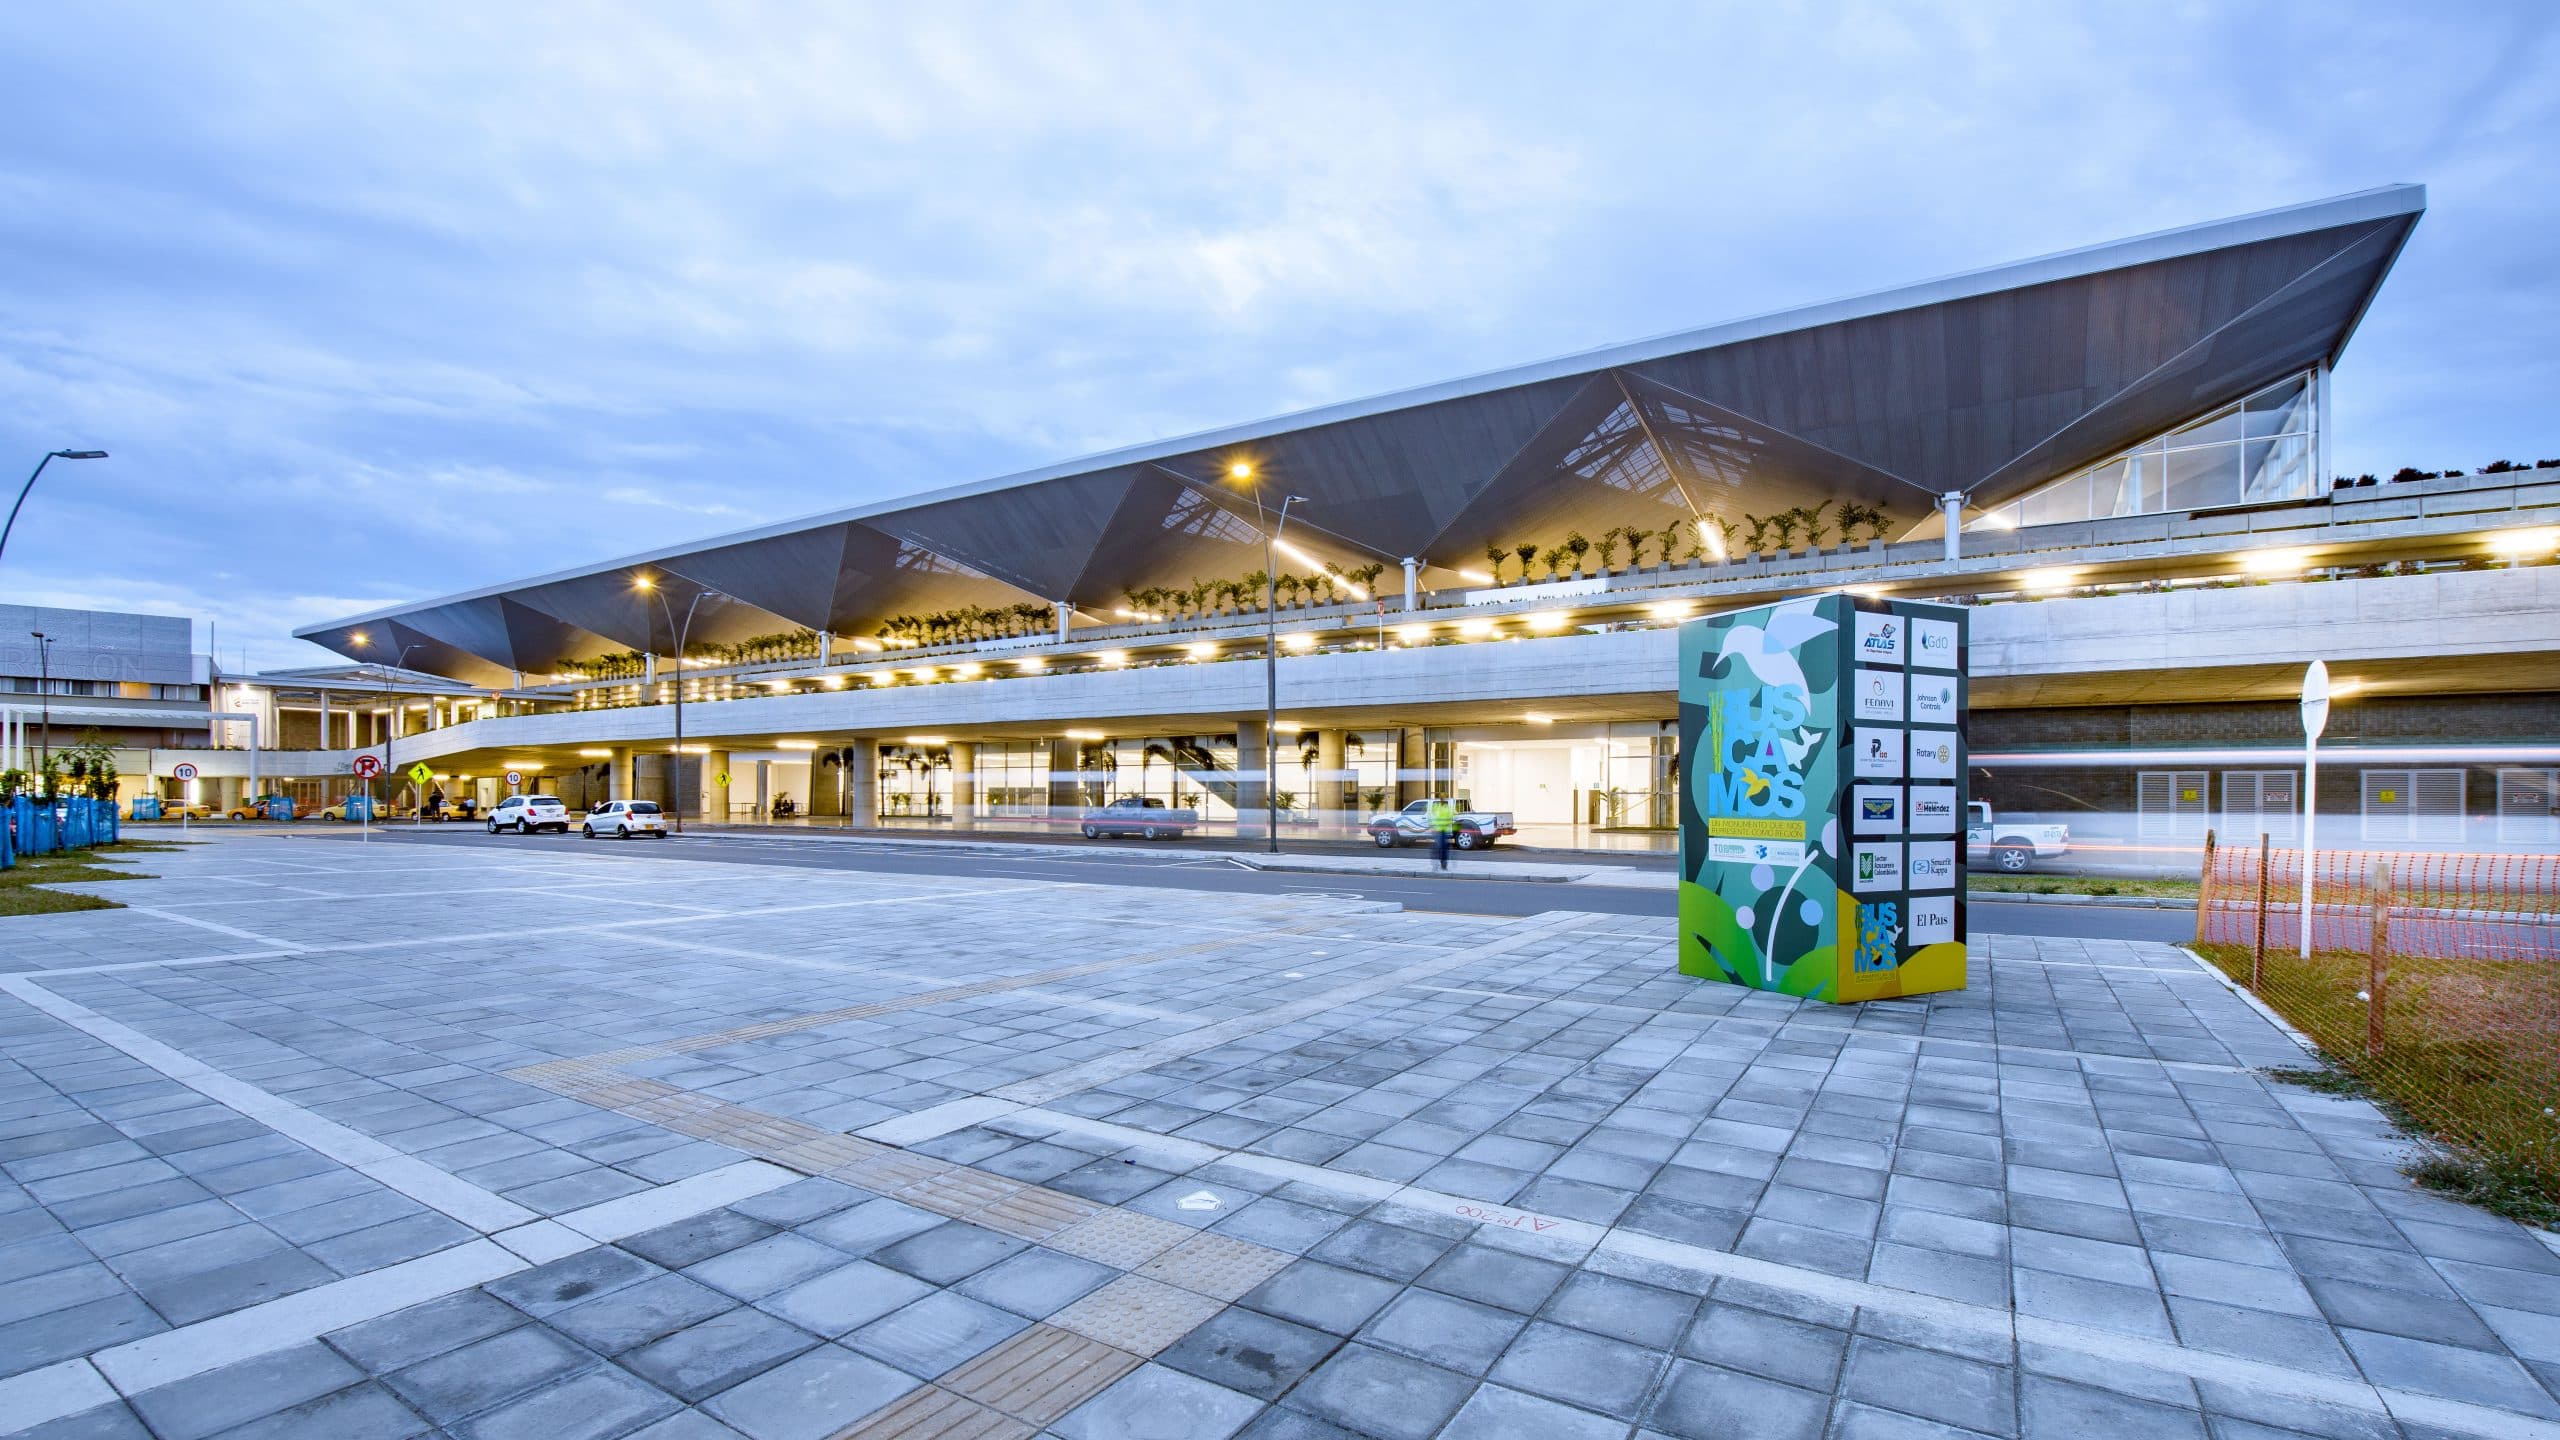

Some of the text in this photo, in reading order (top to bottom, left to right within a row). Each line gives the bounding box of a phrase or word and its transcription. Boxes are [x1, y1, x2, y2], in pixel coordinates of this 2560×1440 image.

[1864, 637, 1895, 649] ATLAS
[1917, 694, 1937, 702] Johnson
[1920, 703, 1941, 711] Controls
[1917, 748, 1937, 759] Rotary
[178, 768, 192, 777] 10
[509, 773, 519, 782] 10
[1917, 914, 1927, 927] El
